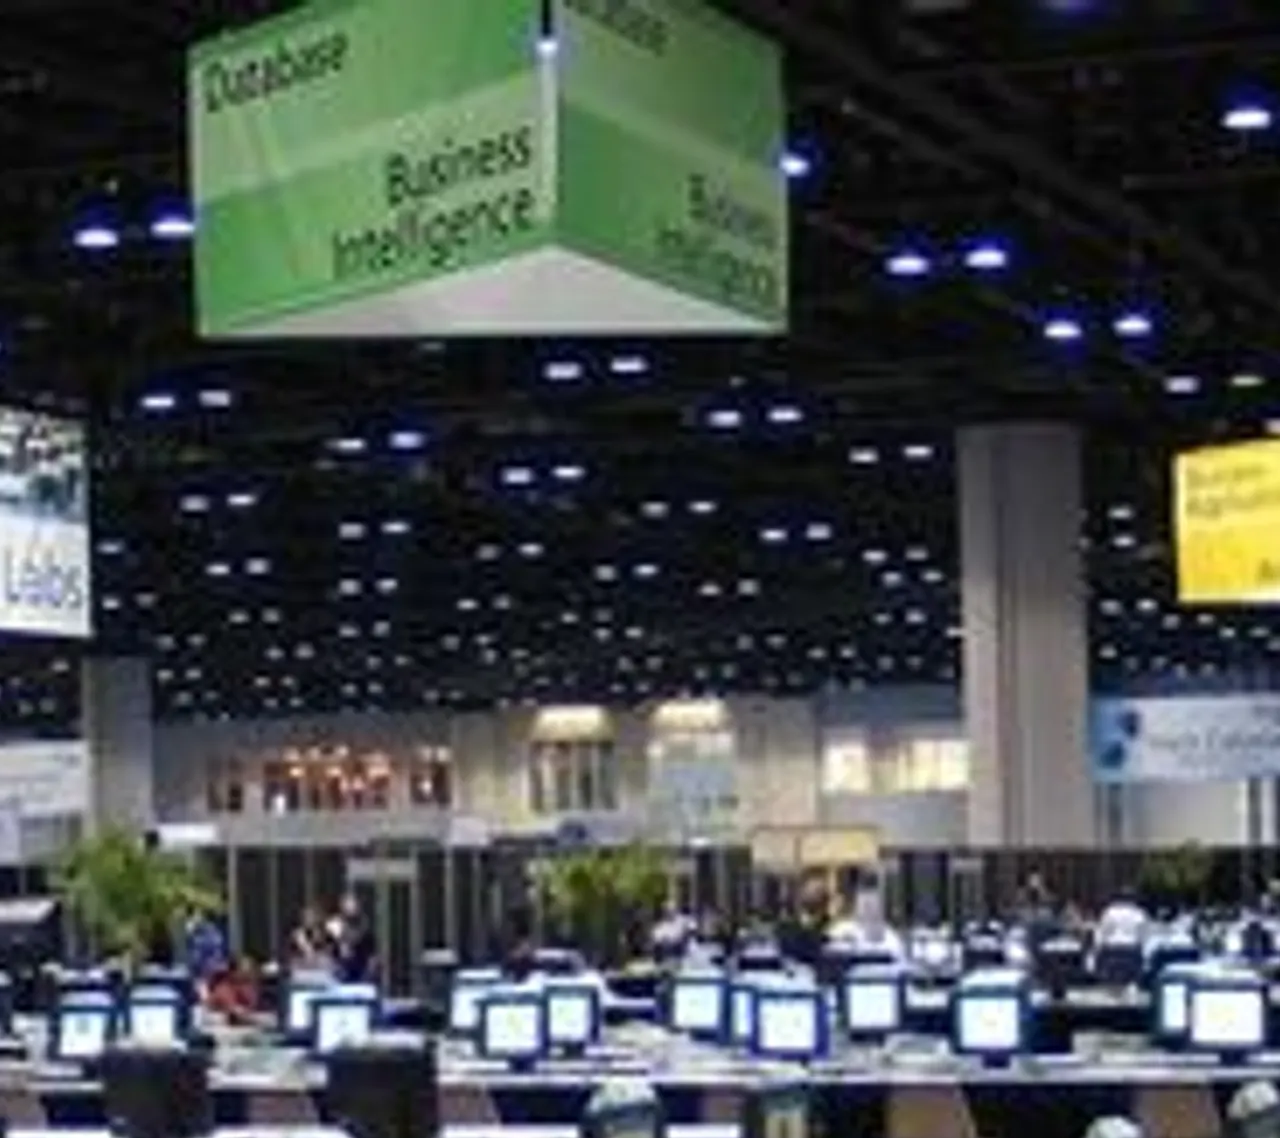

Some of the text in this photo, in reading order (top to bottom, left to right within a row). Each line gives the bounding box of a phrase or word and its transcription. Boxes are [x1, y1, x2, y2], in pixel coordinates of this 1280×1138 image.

[205, 33, 348, 114] Database
[387, 126, 532, 206] Business
[332, 188, 536, 281] Intelligence
[5, 546, 83, 609] Labs
